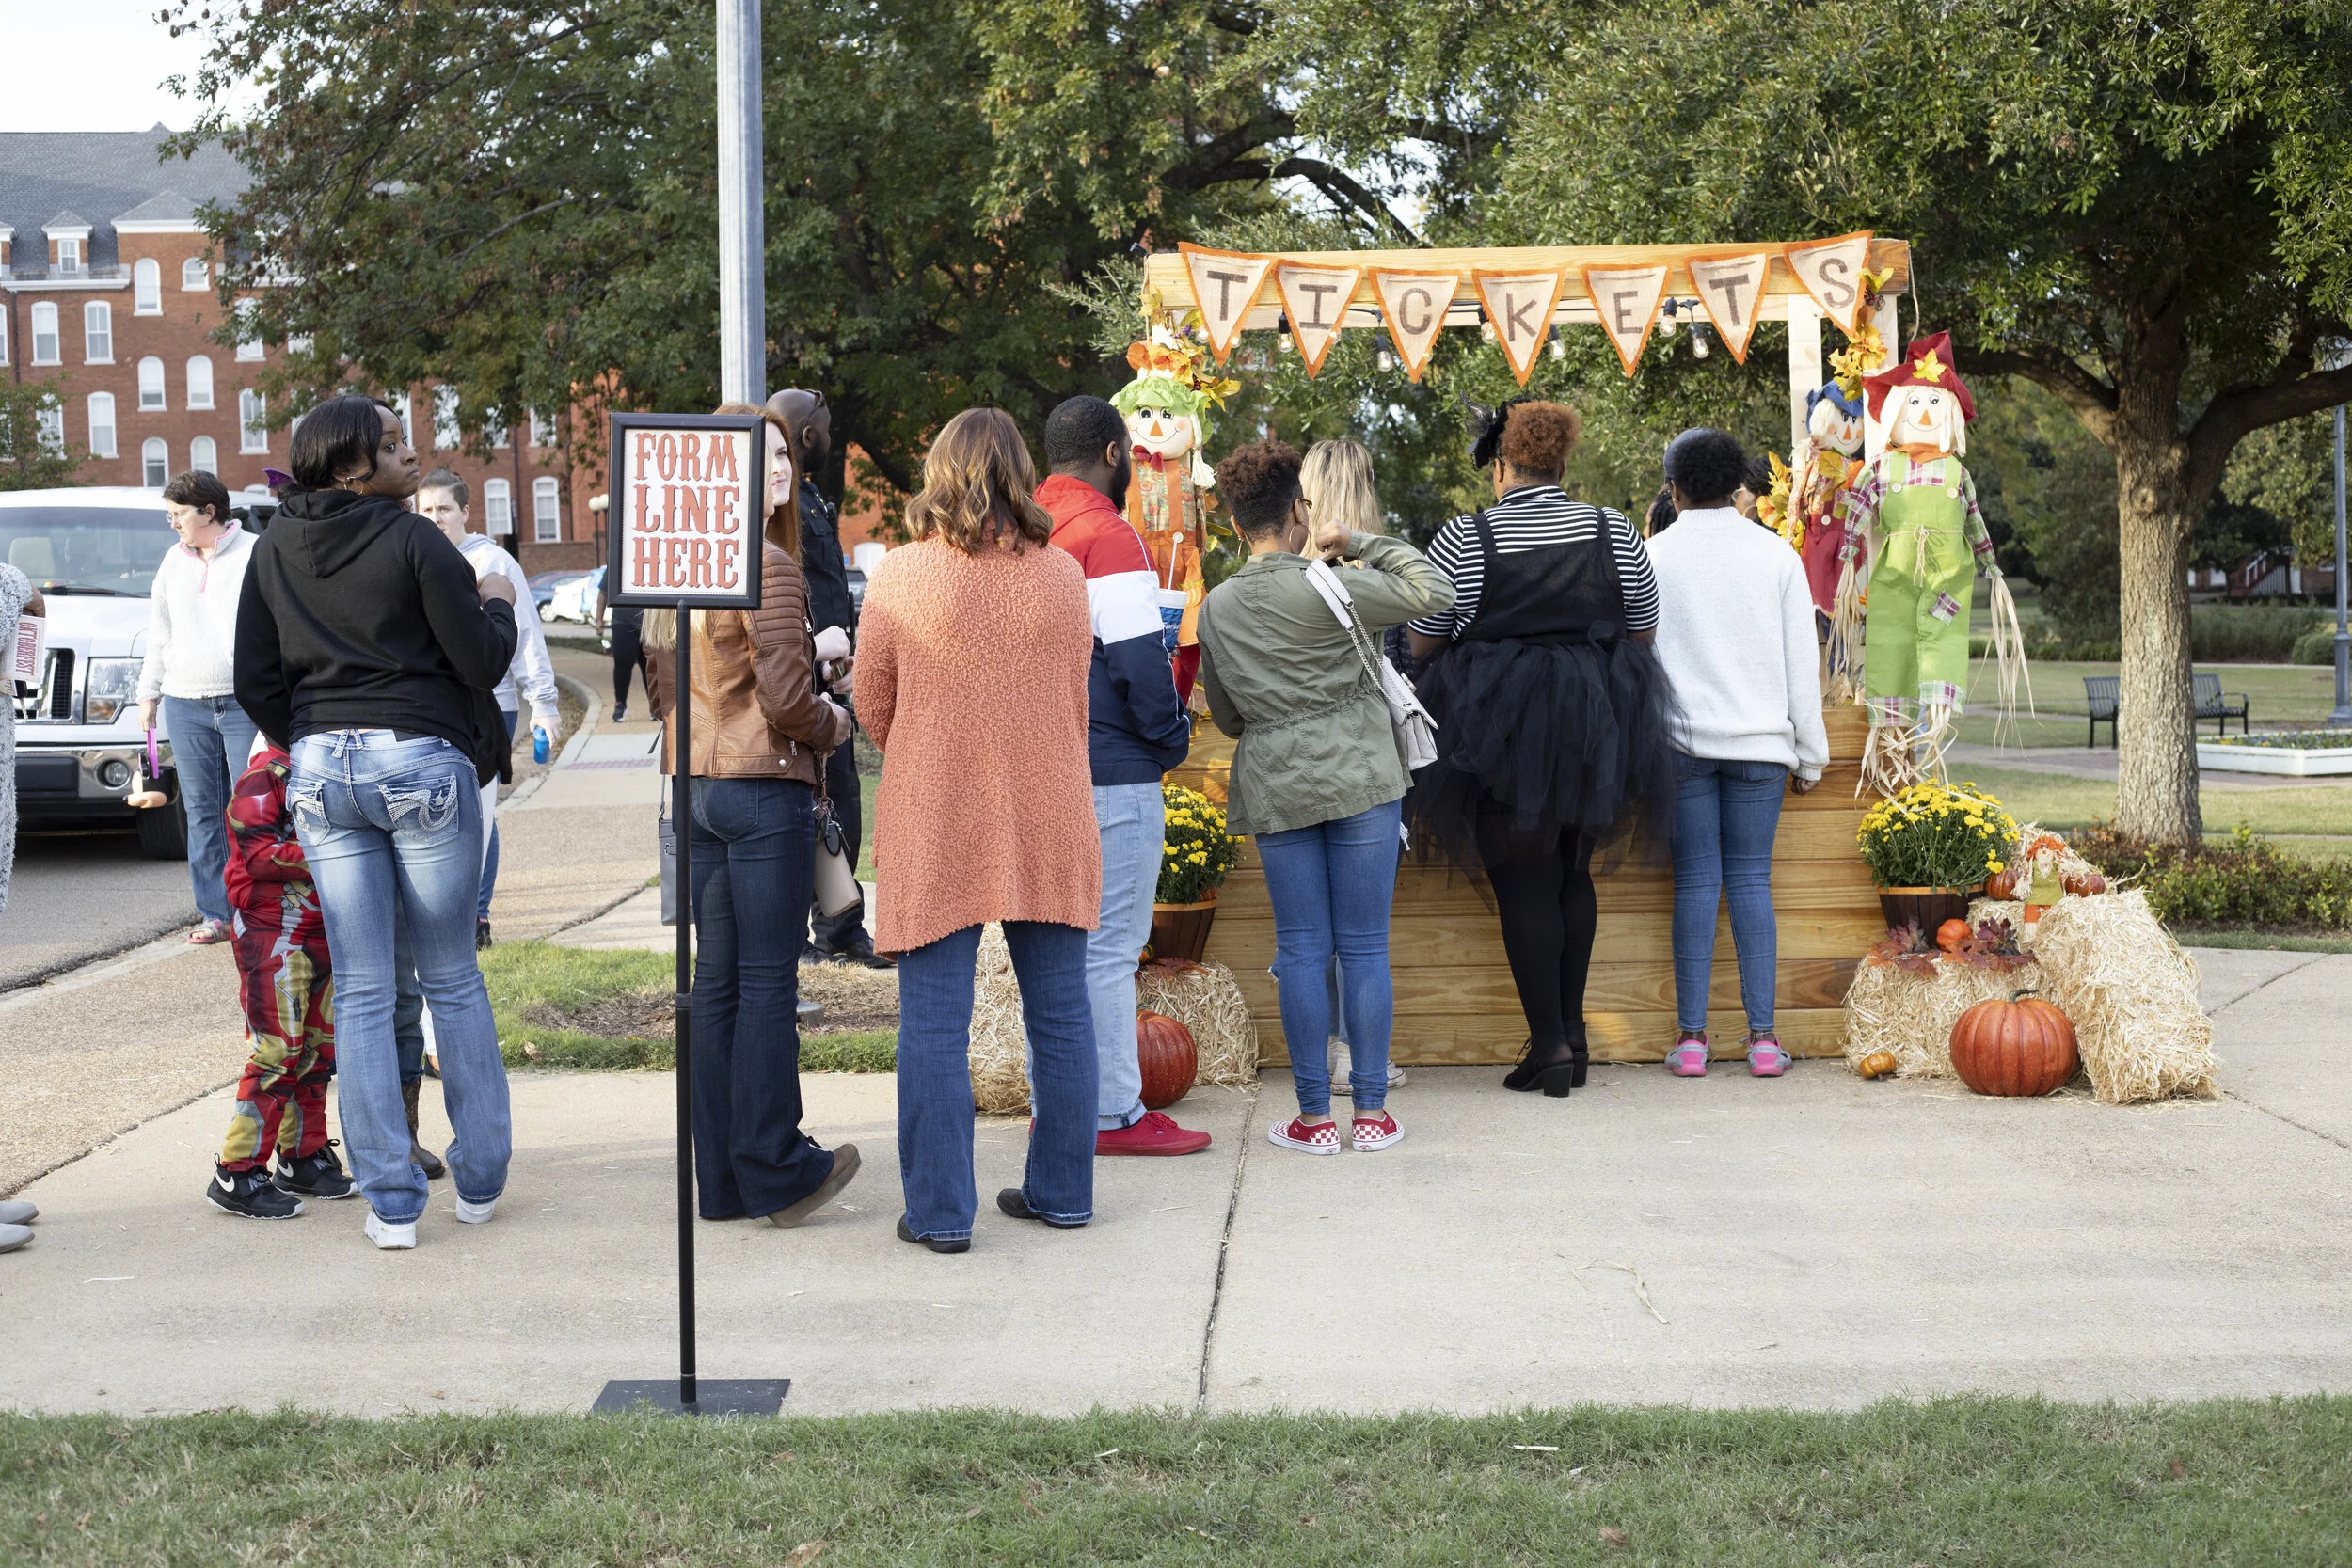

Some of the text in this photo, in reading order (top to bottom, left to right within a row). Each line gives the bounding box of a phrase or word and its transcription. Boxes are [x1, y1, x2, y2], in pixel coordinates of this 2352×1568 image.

[1205, 257, 1856, 342] TICKETS
[634, 433, 739, 482] FORM
[632, 484, 740, 534] LINE
[631, 536, 739, 589] HERE
[15, 622, 38, 676] OKTOBERFEST
